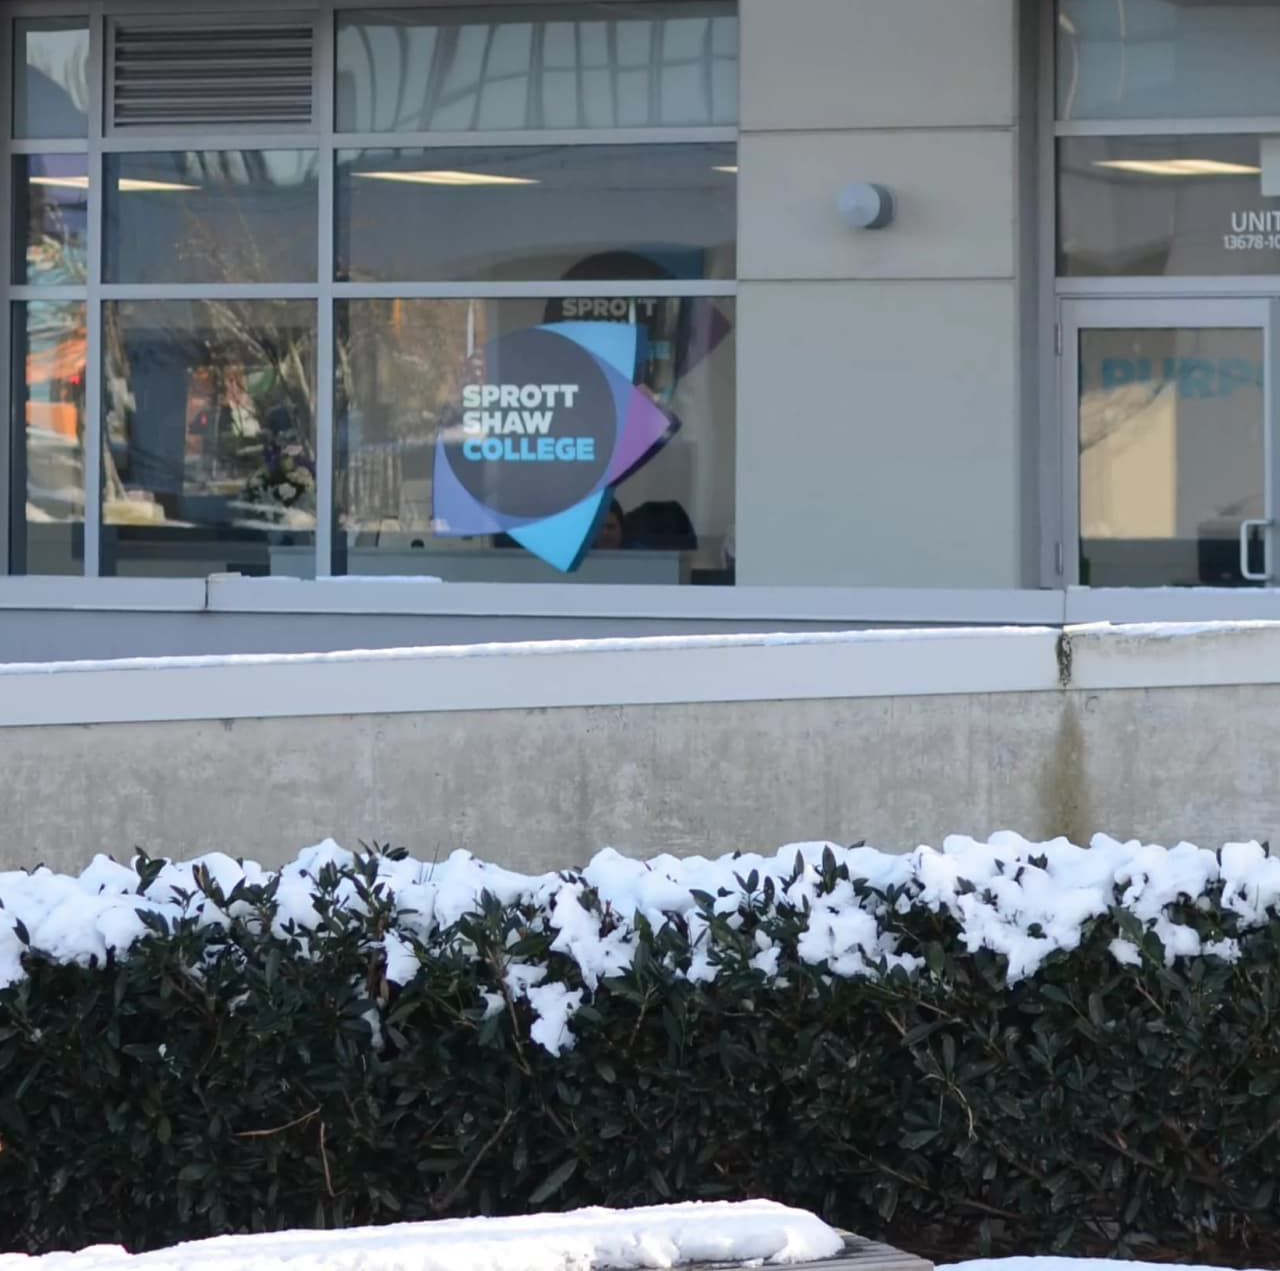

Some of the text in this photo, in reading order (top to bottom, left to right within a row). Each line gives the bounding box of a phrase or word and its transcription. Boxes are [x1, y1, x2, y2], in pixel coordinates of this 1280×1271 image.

[562, 298, 657, 317] SPROT
[462, 384, 579, 408] SPROTT
[462, 410, 554, 435] SHAW
[462, 436, 596, 461] COLLEGE
